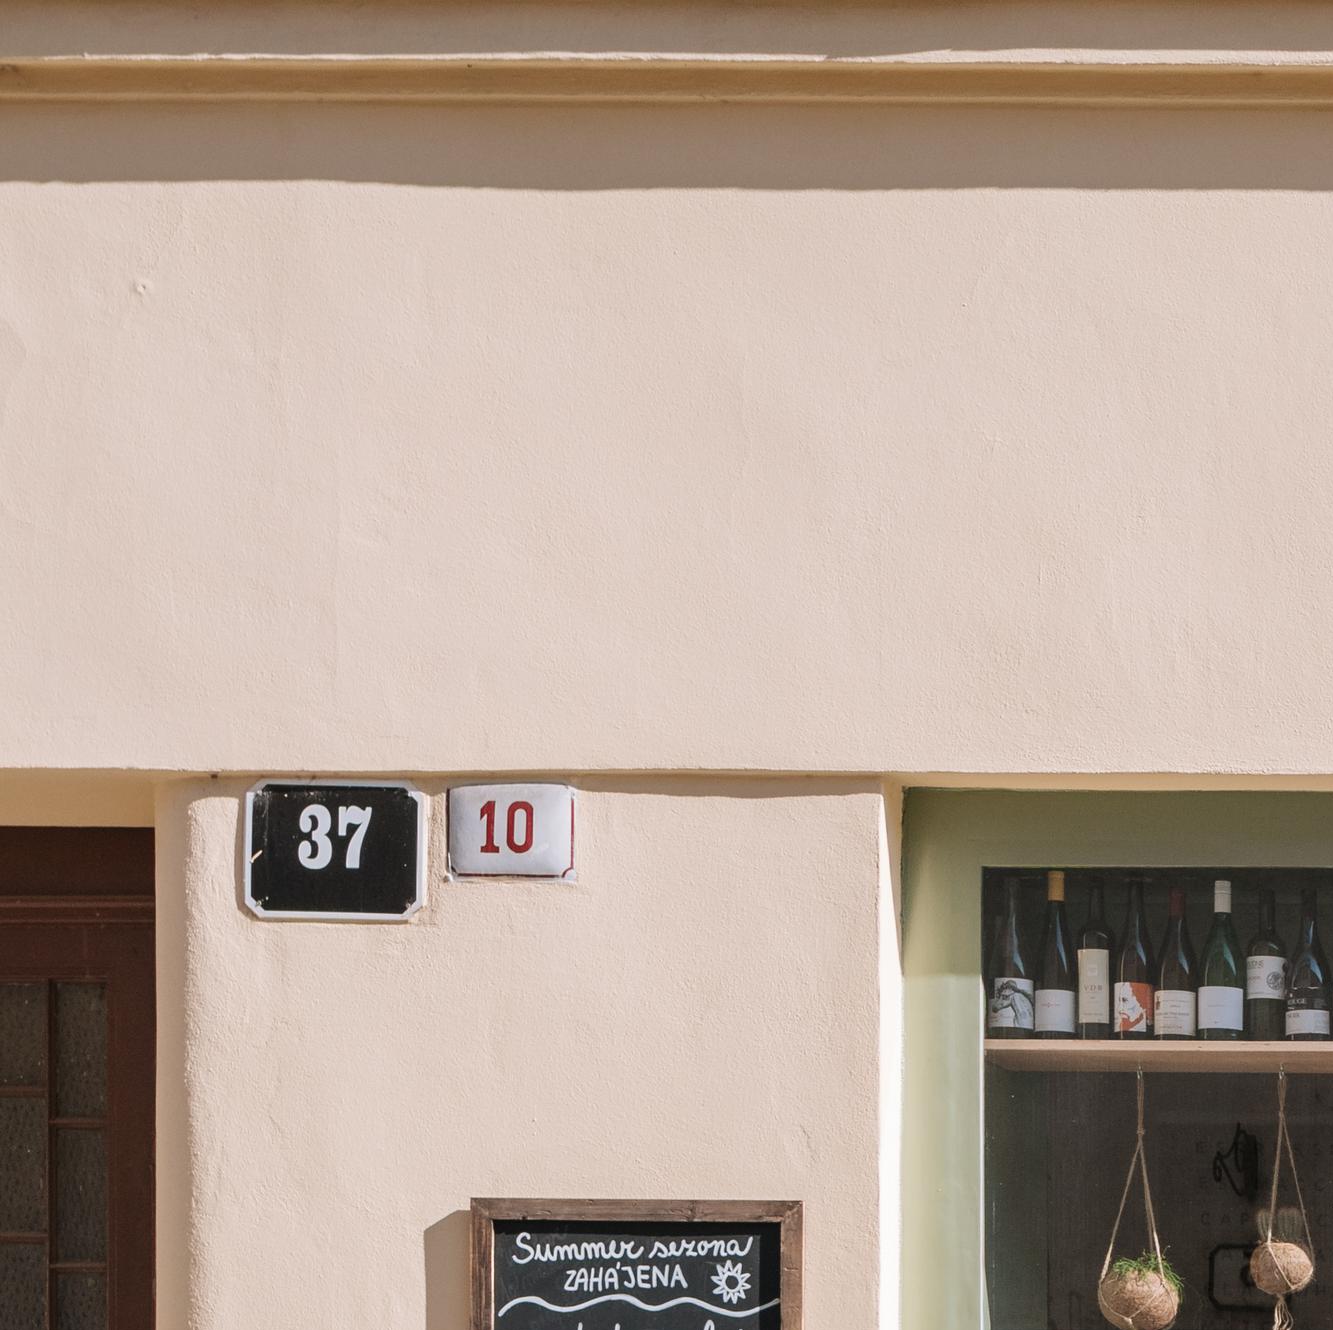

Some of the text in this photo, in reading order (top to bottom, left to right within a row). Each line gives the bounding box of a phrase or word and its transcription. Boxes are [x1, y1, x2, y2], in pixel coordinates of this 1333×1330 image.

[298, 804, 372, 870] 37
[480, 800, 534, 854] 10
[512, 1232, 754, 1264] Summer sezona
[563, 1261, 689, 1292] ZAHÁJENA
